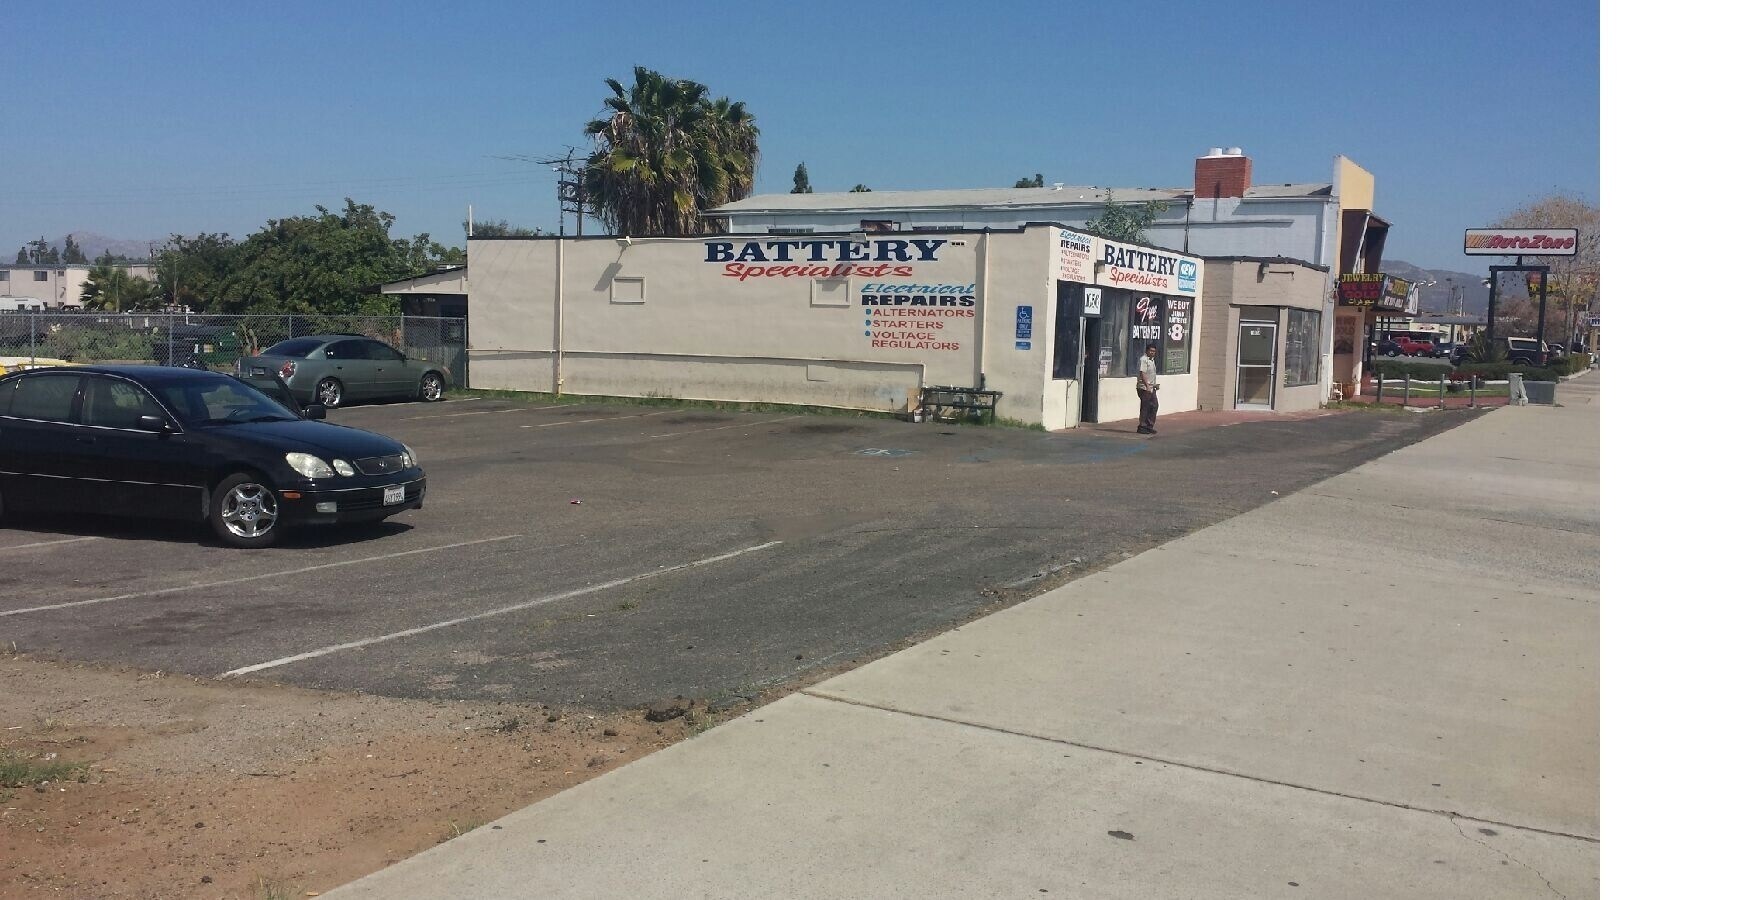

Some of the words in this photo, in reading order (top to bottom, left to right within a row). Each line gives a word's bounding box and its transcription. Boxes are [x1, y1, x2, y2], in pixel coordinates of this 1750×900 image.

[1060, 239, 1091, 253] REPAIRS
[1489, 234, 1575, 249] AutoZone
[704, 240, 948, 263] BATTERY
[1104, 244, 1177, 275] BATTERY
[721, 262, 913, 281] Specialists
[1109, 267, 1168, 288] Specialists
[1341, 273, 1384, 282] JEWELRY
[860, 283, 976, 295] Electrical
[1344, 290, 1378, 298] GOLD
[861, 295, 976, 307] REPAIRS
[1167, 300, 1177, 309] WE
[873, 308, 975, 318] ALTERNATORS
[872, 320, 944, 329] STARTERS
[872, 331, 936, 340] VOLTAGE
[871, 340, 960, 350] REGULATORS
